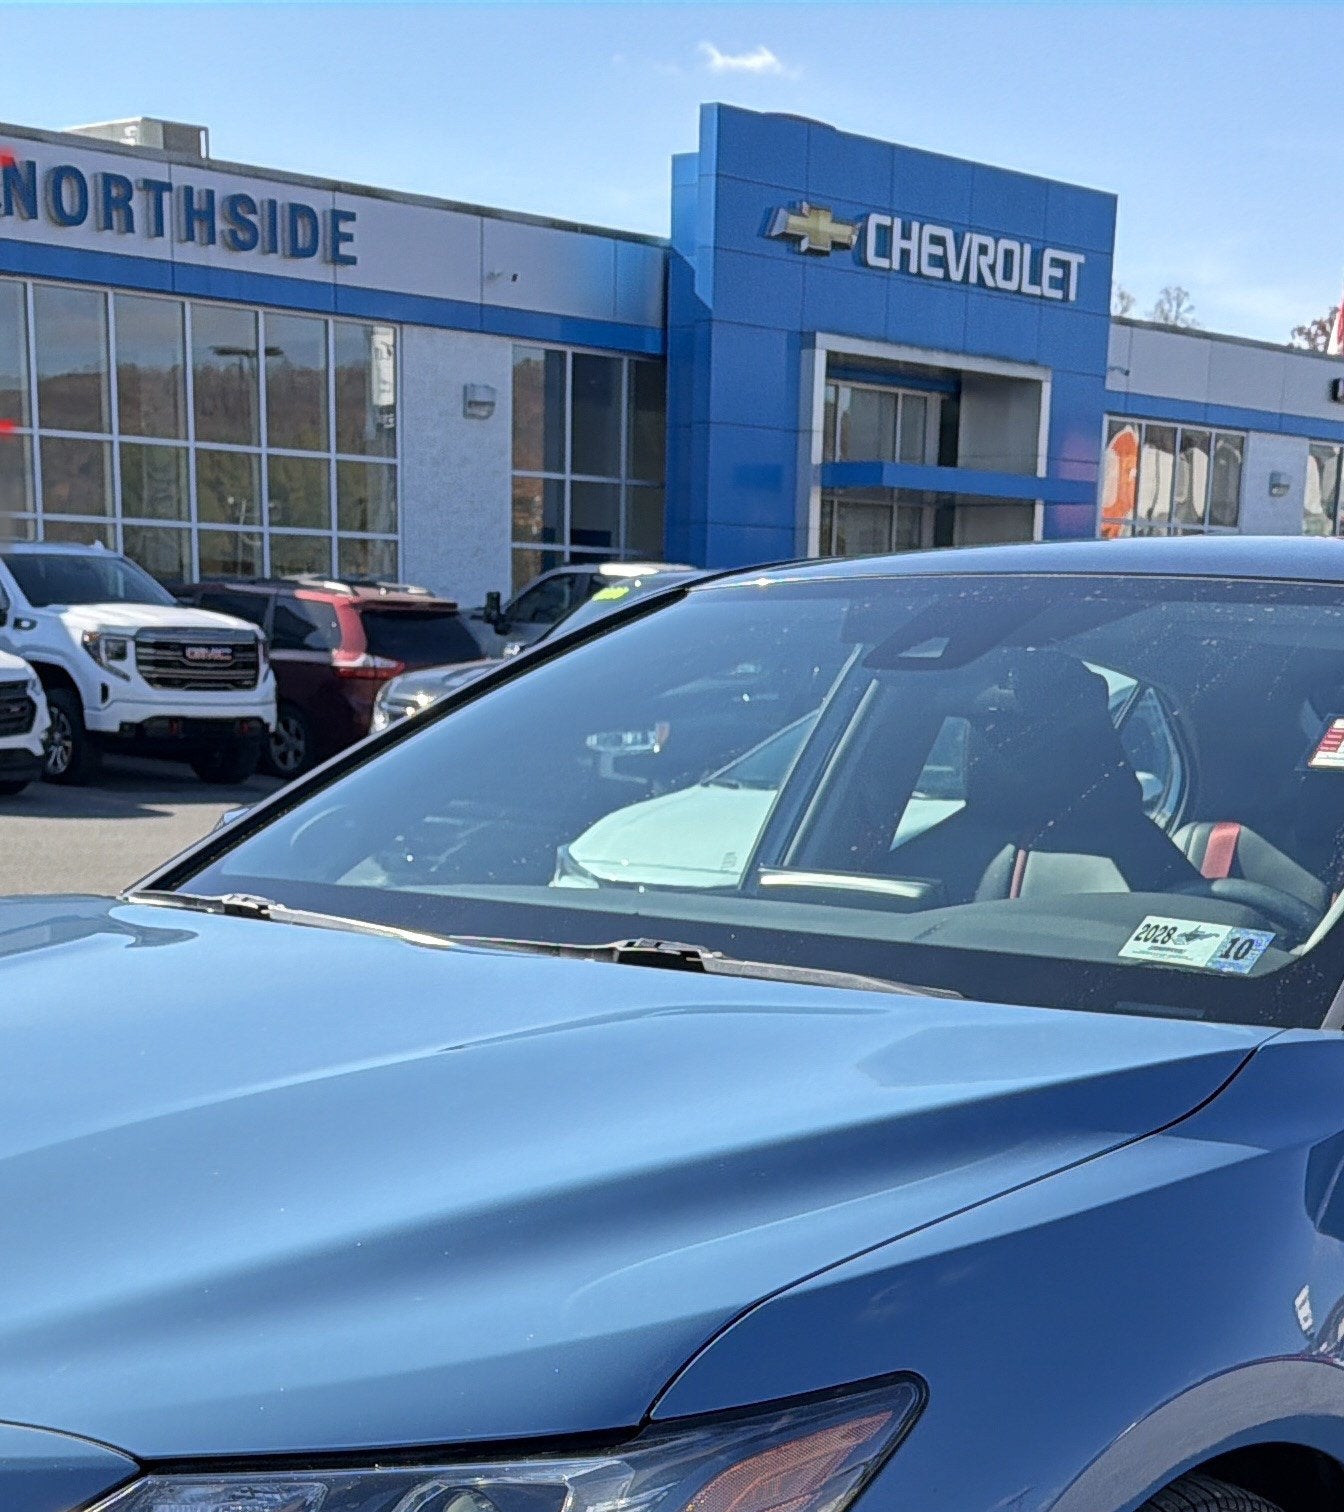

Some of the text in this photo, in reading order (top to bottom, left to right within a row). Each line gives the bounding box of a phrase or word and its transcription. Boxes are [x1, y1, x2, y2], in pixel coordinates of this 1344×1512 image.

[865, 212, 1087, 302] CHEVROLET
[1134, 923, 1178, 945] 2028
[1219, 936, 1256, 961] 10
